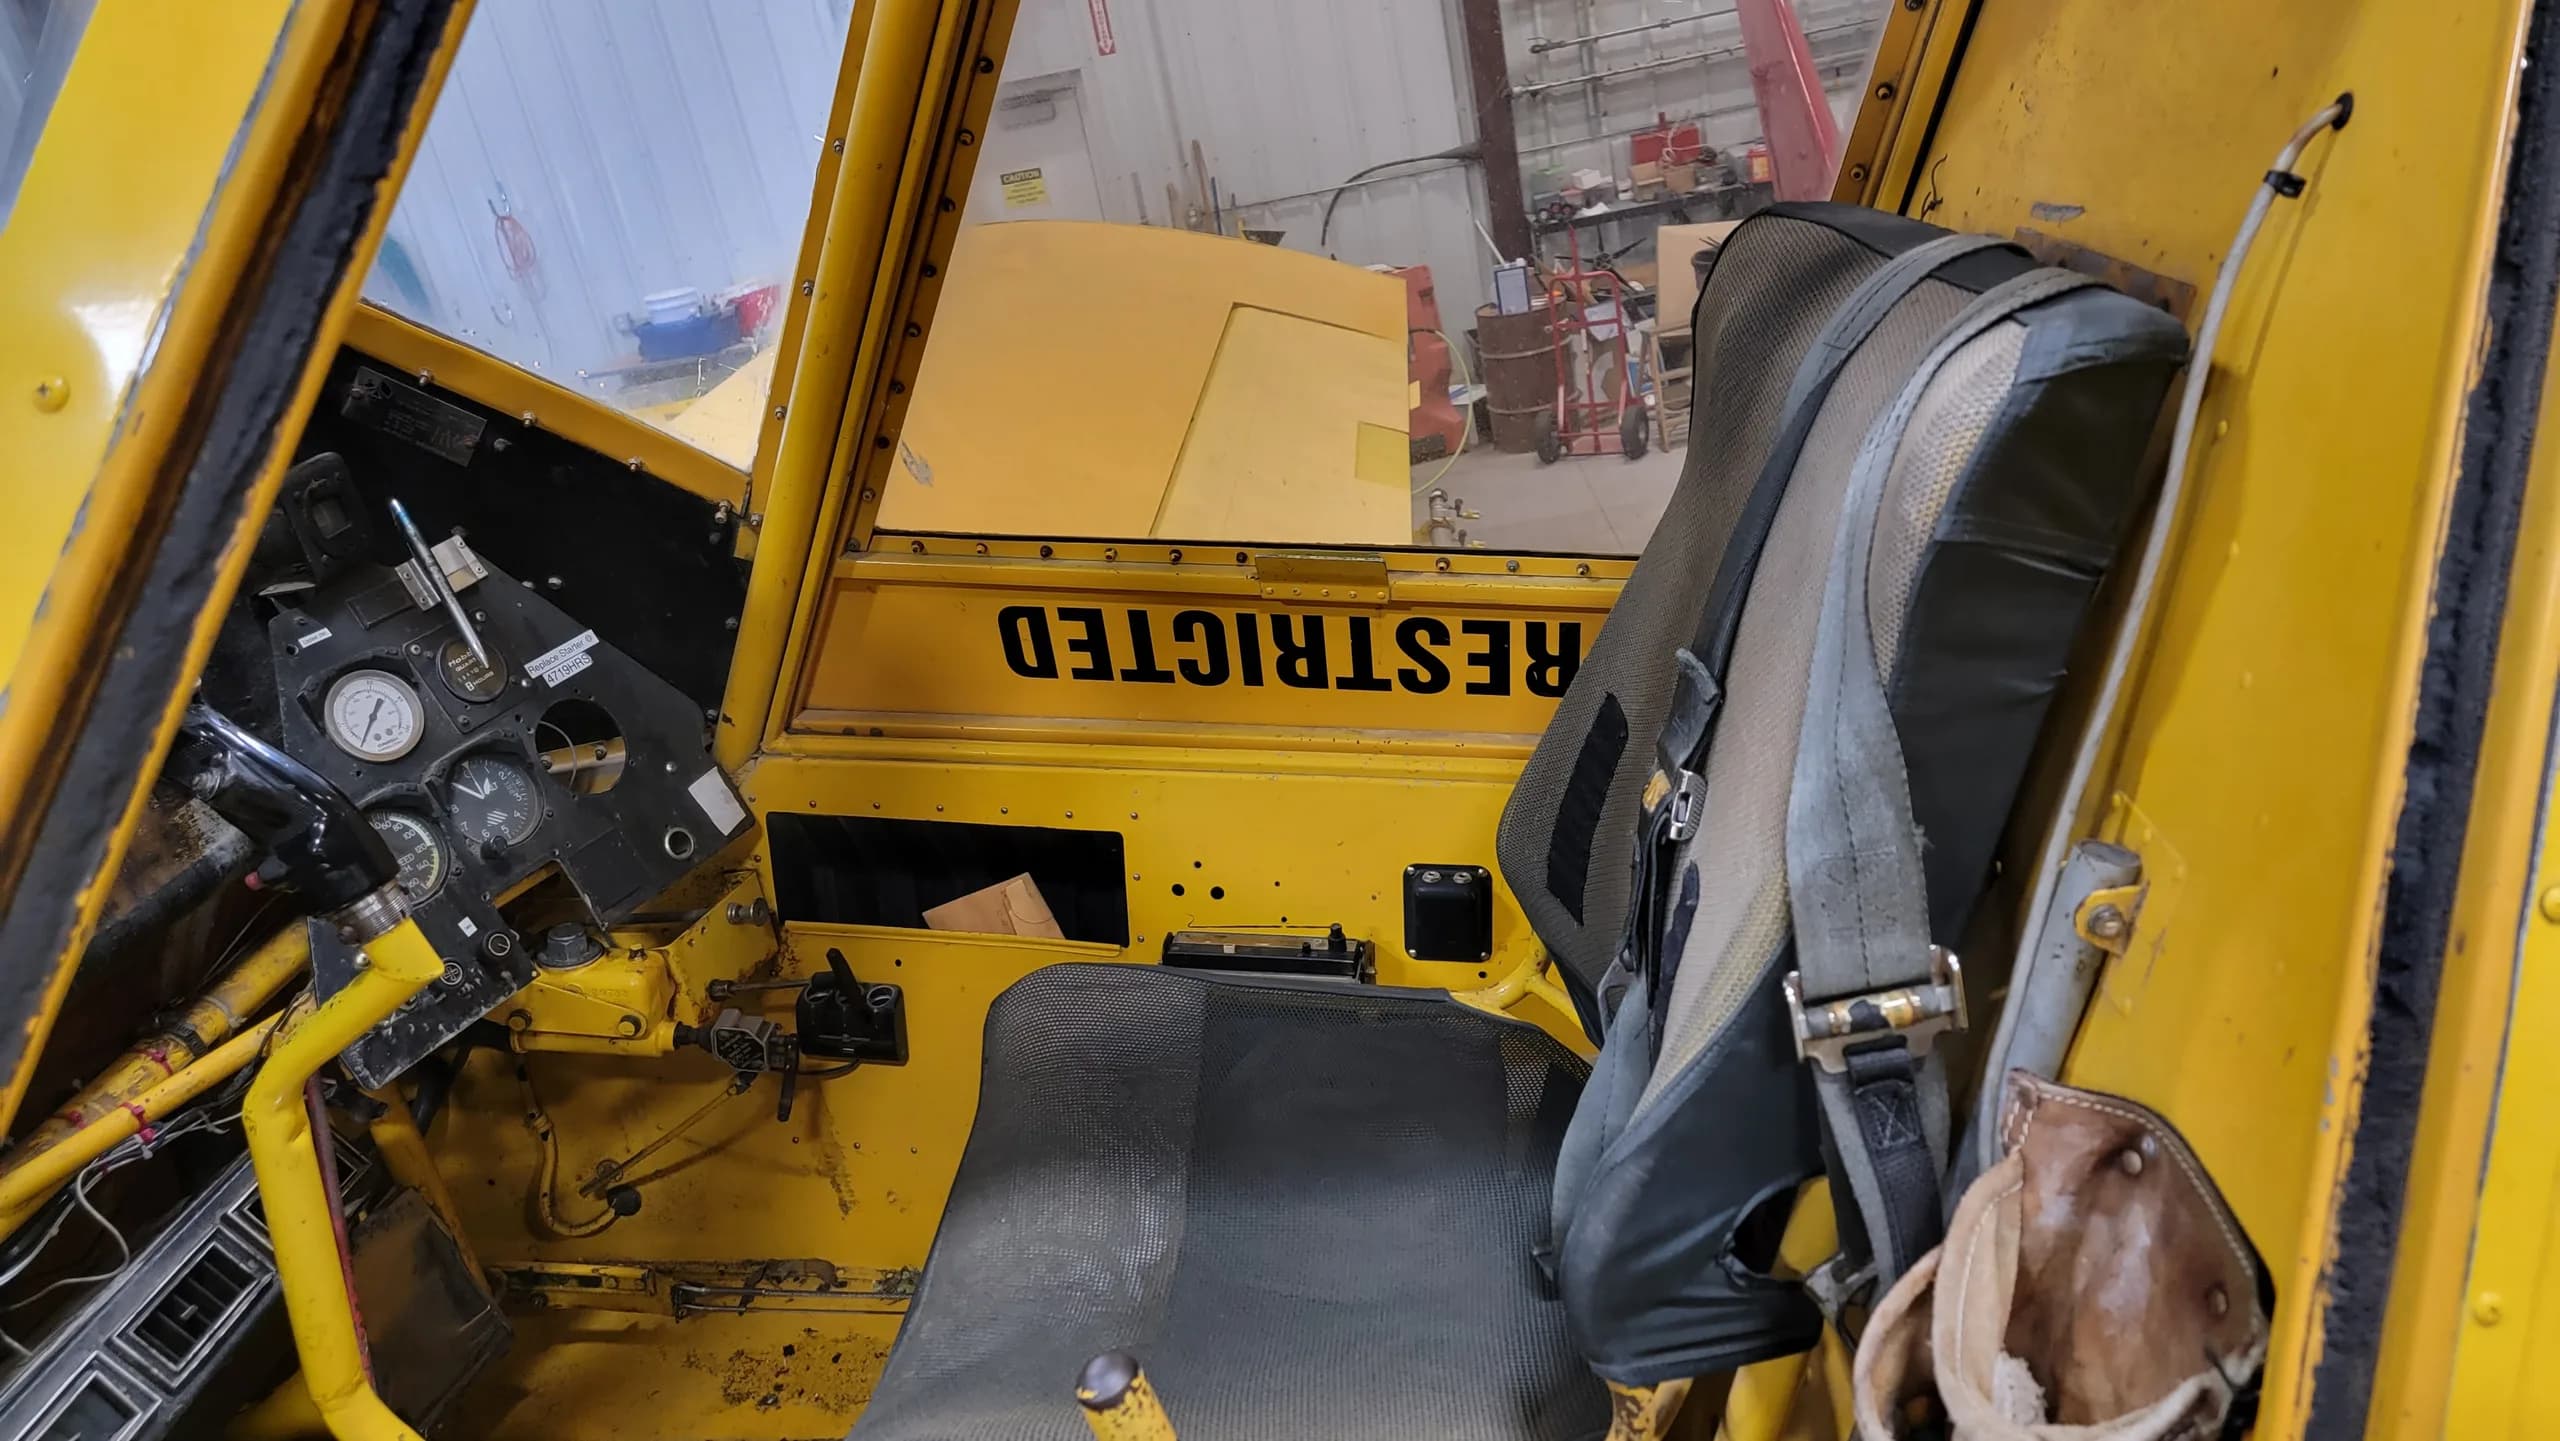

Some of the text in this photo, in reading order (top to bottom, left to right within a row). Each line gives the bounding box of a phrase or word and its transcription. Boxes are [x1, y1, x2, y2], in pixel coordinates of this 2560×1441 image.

[448, 648, 473, 667] Hobb
[528, 653, 560, 675] Replace
[558, 639, 585, 658] Starter
[997, 605, 1583, 698] RESTRICTED
[547, 654, 592, 684] 4719HRS
